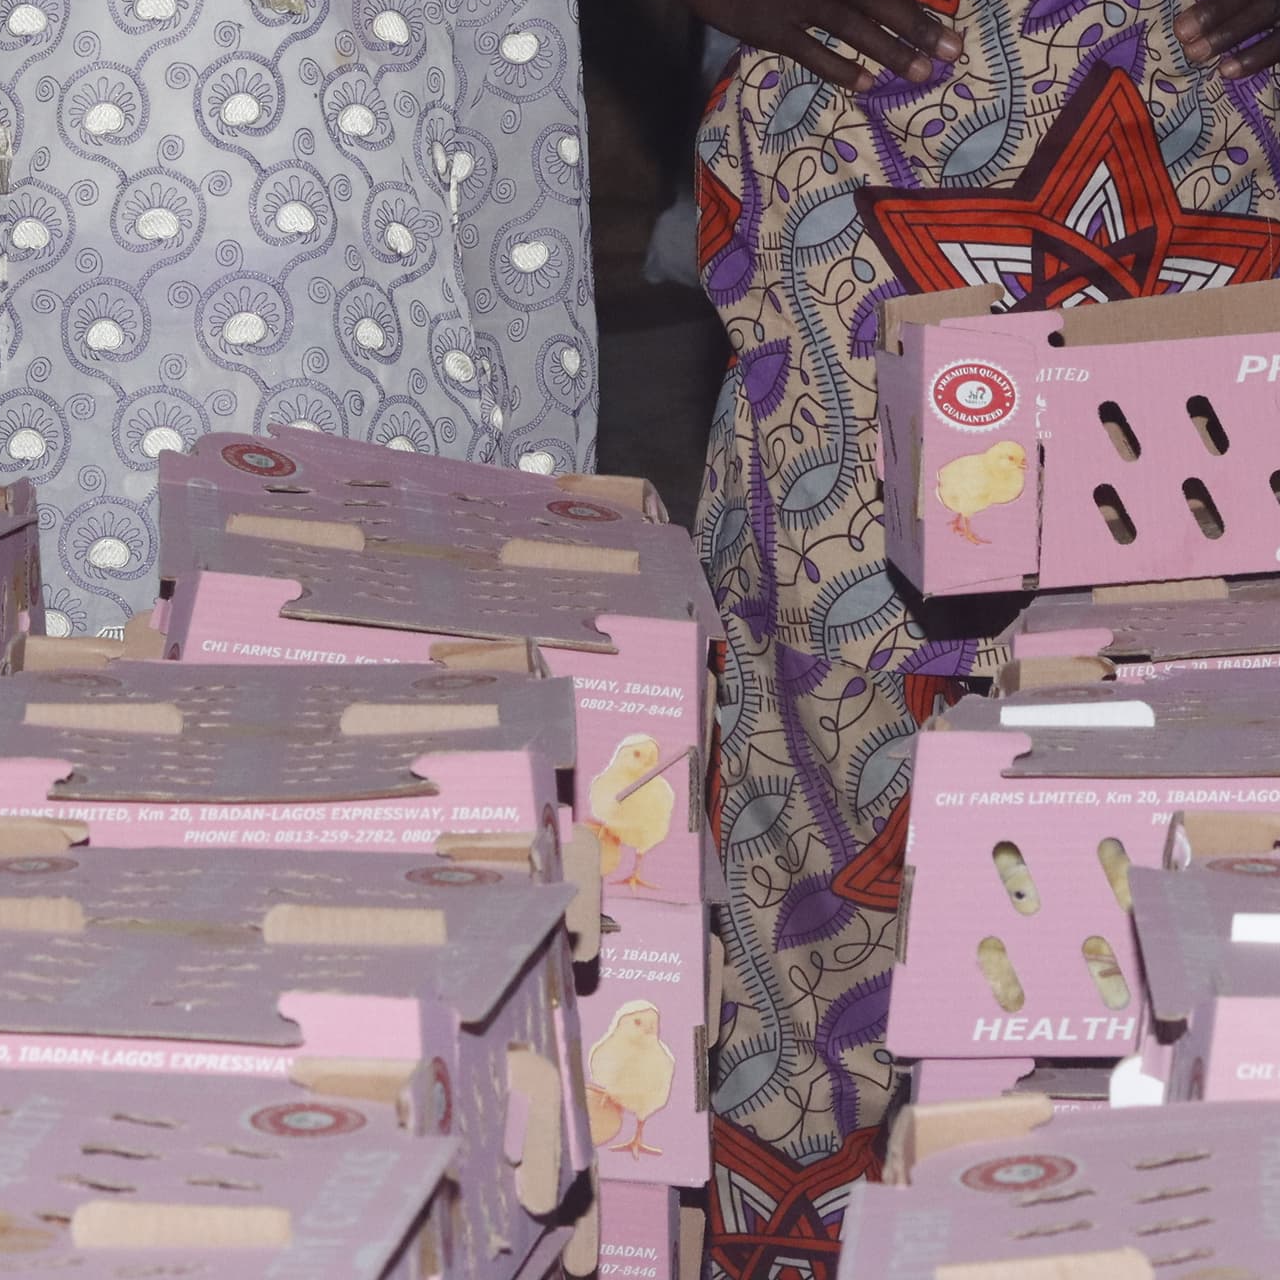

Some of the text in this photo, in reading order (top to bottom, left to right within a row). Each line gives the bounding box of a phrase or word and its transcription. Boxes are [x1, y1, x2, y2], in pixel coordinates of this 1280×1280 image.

[938, 367, 1013, 398] PREMIUM QUALITY
[942, 401, 1004, 424] GUARANTEED
[202, 640, 228, 653] CHI
[232, 643, 281, 658] FARMS
[285, 648, 346, 664] LIMITED
[623, 682, 685, 701] IBADAN,
[580, 697, 683, 718] 0802-207-8446
[936, 792, 965, 806] CHI
[969, 792, 1024, 805] FARMS
[1029, 791, 1101, 806] LIMITED,
[1106, 790, 1132, 804] Km
[1137, 790, 1161, 805] 20,
[59, 807, 130, 823] LIMITED,
[138, 807, 164, 821] Km
[170, 807, 193, 823] 20,
[200, 807, 324, 821] IBADAN-LAGOS
[331, 807, 445, 822] EXPRESSWAY,
[451, 807, 520, 822] IBADAN,
[184, 830, 238, 843] PHONE
[242, 830, 270, 843] NO:
[623, 948, 683, 966] IBADAN,
[972, 1017, 1136, 1041] HEALTH
[18, 1046, 164, 1068] IBADAN-LAGOS
[1236, 1063, 1273, 1080] CHI
[600, 1243, 658, 1261] IBADAN,
